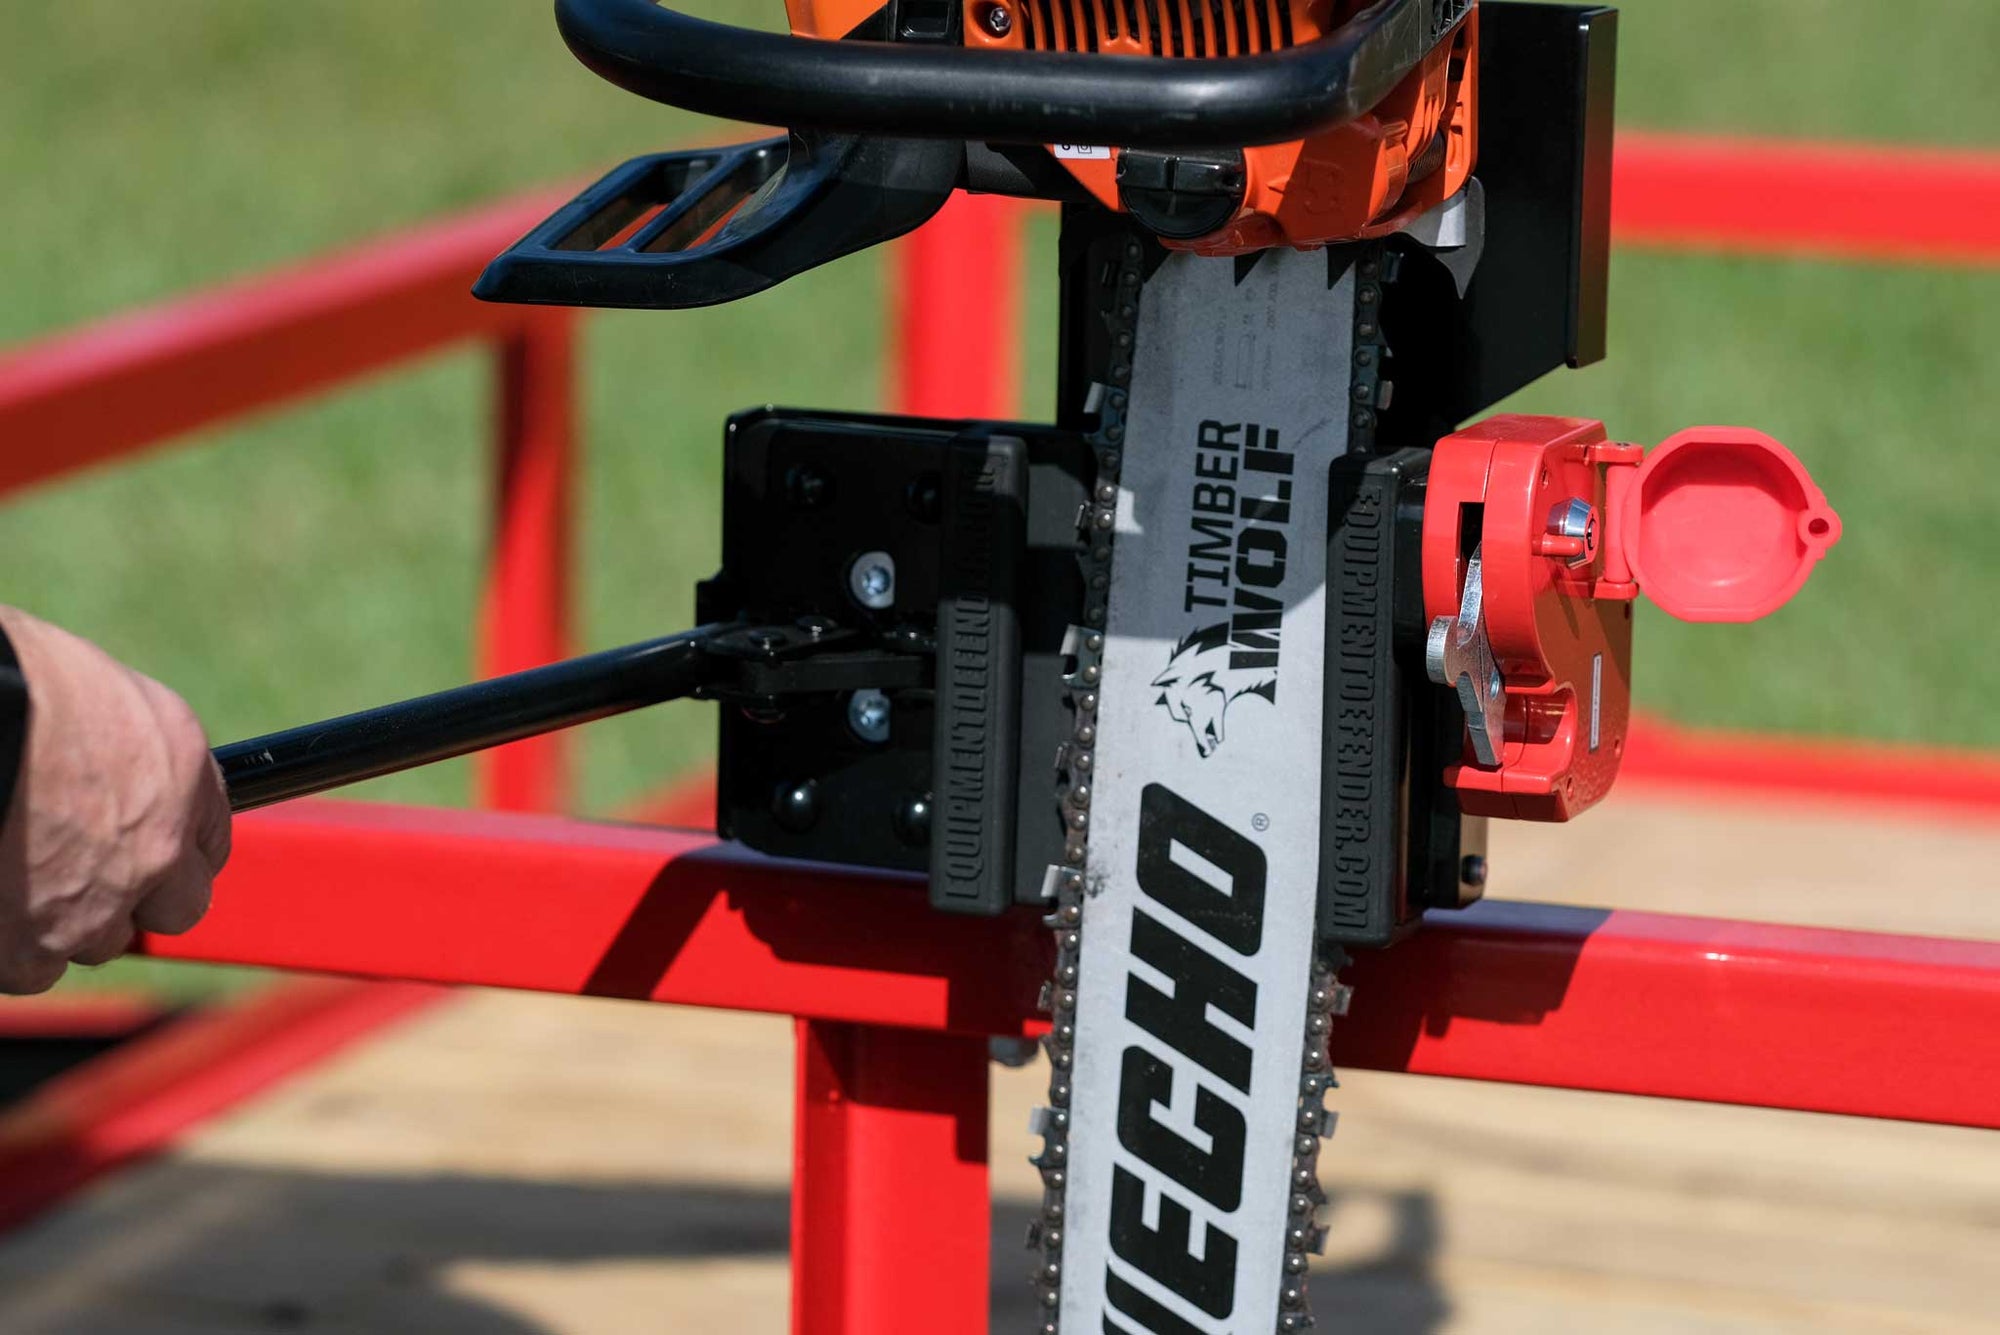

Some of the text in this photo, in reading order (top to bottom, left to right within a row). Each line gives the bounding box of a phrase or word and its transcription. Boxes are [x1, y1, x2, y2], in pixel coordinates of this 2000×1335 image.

[1186, 418, 1242, 613] TIMBER
[1229, 423, 1295, 671] WOLF
[1109, 782, 1268, 1321] ECHO
